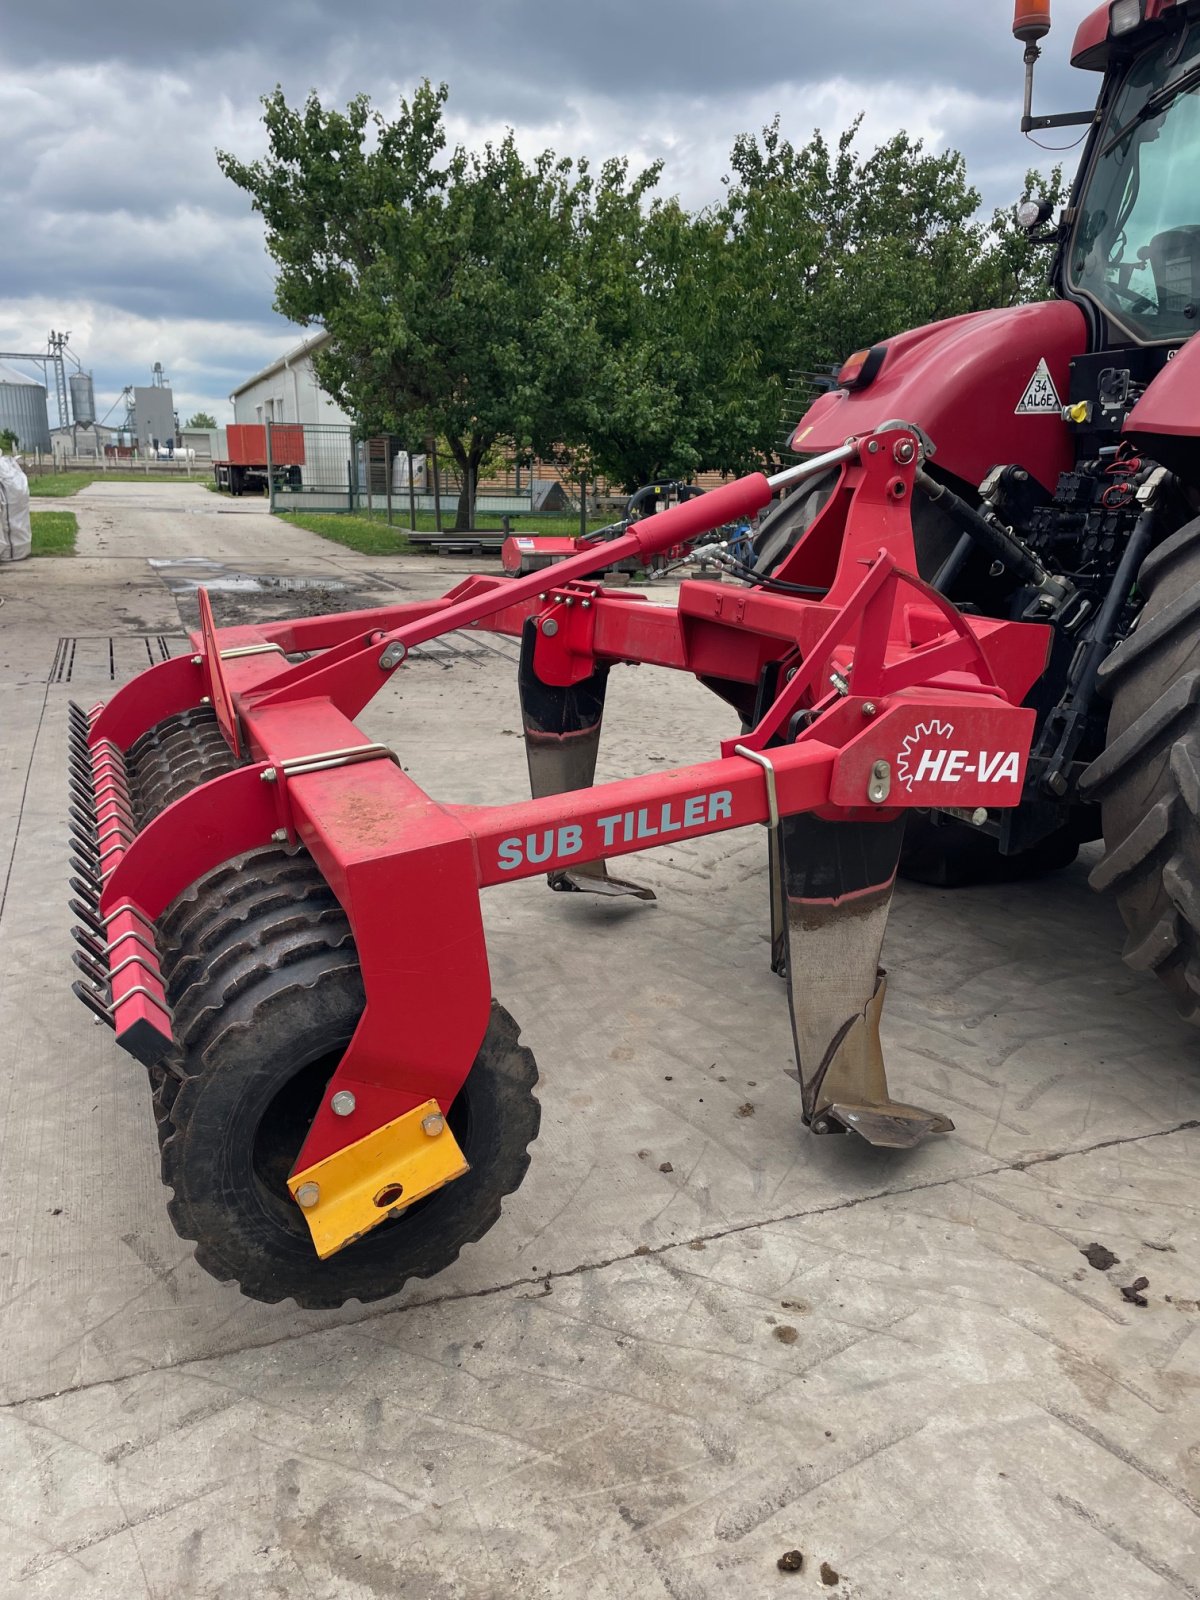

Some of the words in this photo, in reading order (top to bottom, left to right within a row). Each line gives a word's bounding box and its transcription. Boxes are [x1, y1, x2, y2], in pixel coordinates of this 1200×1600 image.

[1034, 380, 1047, 393] 34
[914, 749, 1020, 782] HE-VA
[497, 824, 583, 870] SUB
[597, 790, 733, 846] TILLER
